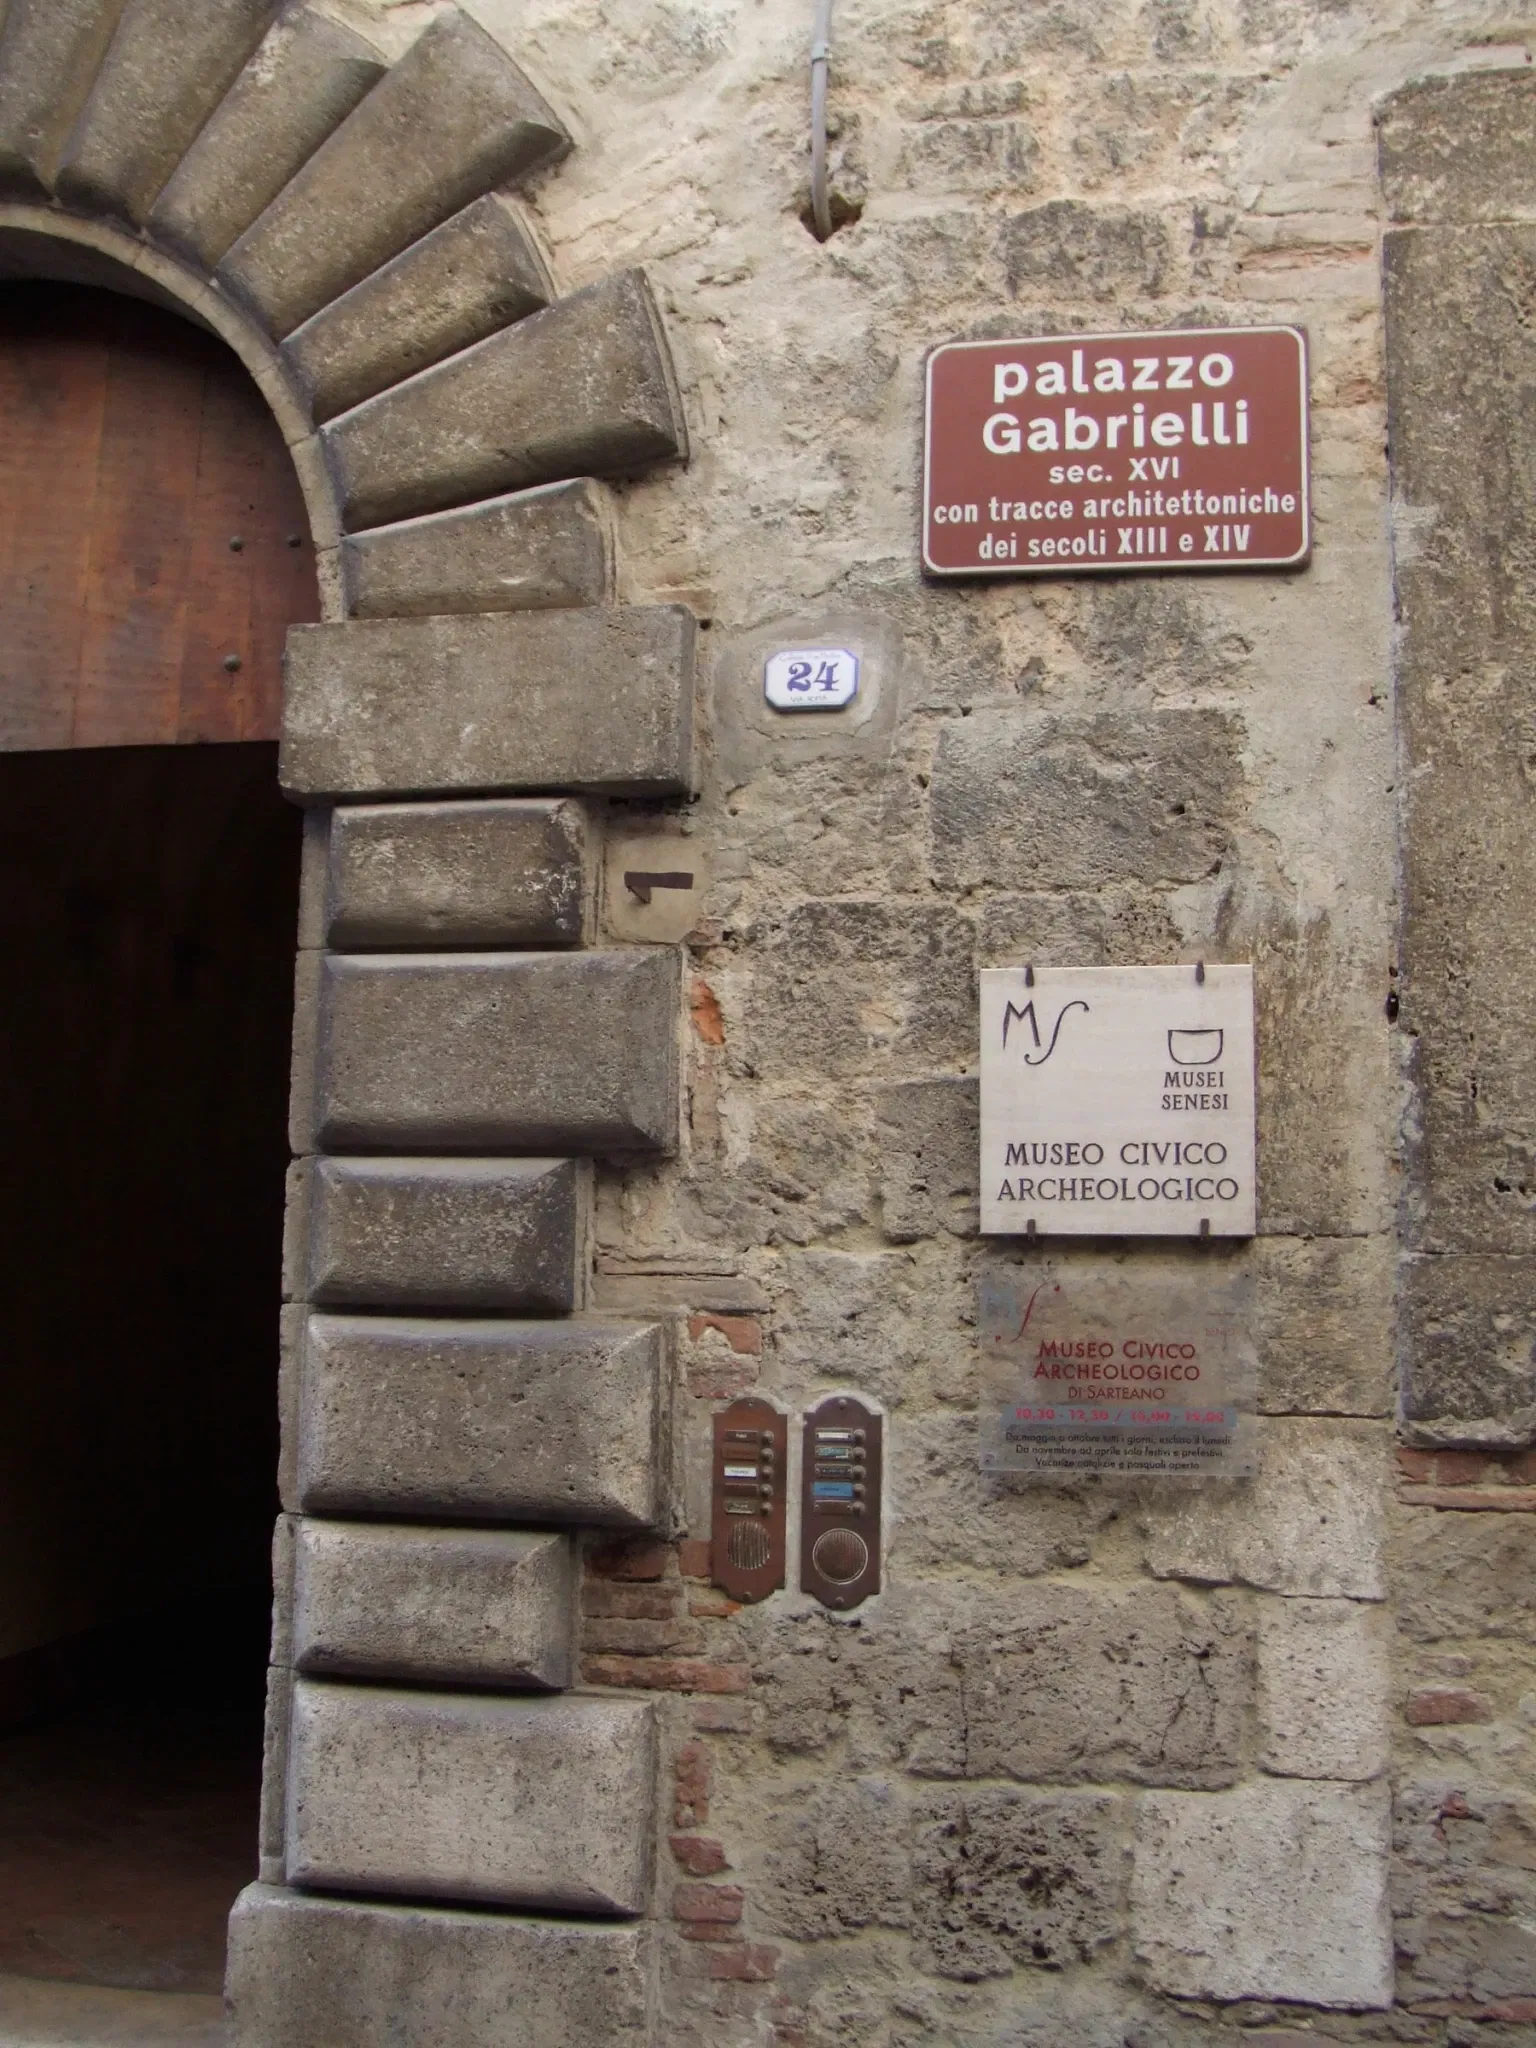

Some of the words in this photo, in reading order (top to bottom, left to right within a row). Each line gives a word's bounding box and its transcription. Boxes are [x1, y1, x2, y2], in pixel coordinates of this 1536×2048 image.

[993, 349, 1234, 403] palazzo
[982, 399, 1249, 454] Gabrielli
[1048, 463, 1113, 484] sec.
[1128, 456, 1180, 481] XVI
[933, 502, 978, 524] con
[989, 496, 1073, 522] tracce
[1083, 487, 1296, 519] architettoniche
[978, 532, 1017, 560] dei
[1027, 528, 1107, 558] secoli
[1117, 527, 1167, 555] XIII
[1178, 534, 1194, 553] e
[1203, 524, 1251, 552] XIV
[786, 661, 841, 692] 24
[1163, 1071, 1225, 1088] MUSEI
[1161, 1093, 1229, 1110] SENESI
[1004, 1142, 1104, 1166] MUSEO
[1120, 1142, 1228, 1165] CIVICO
[997, 1178, 1239, 1201] ARCHEOLOGICO
[1037, 1339, 1114, 1360] MUSEO
[1122, 1340, 1196, 1360] CIVICO
[1033, 1363, 1200, 1381] ARCHEOLOGICO
[1067, 1386, 1085, 1399] DI
[1087, 1385, 1166, 1400] SARTEANO
[1016, 1444, 1029, 1454] Da
[1032, 1445, 1077, 1455] novembre
